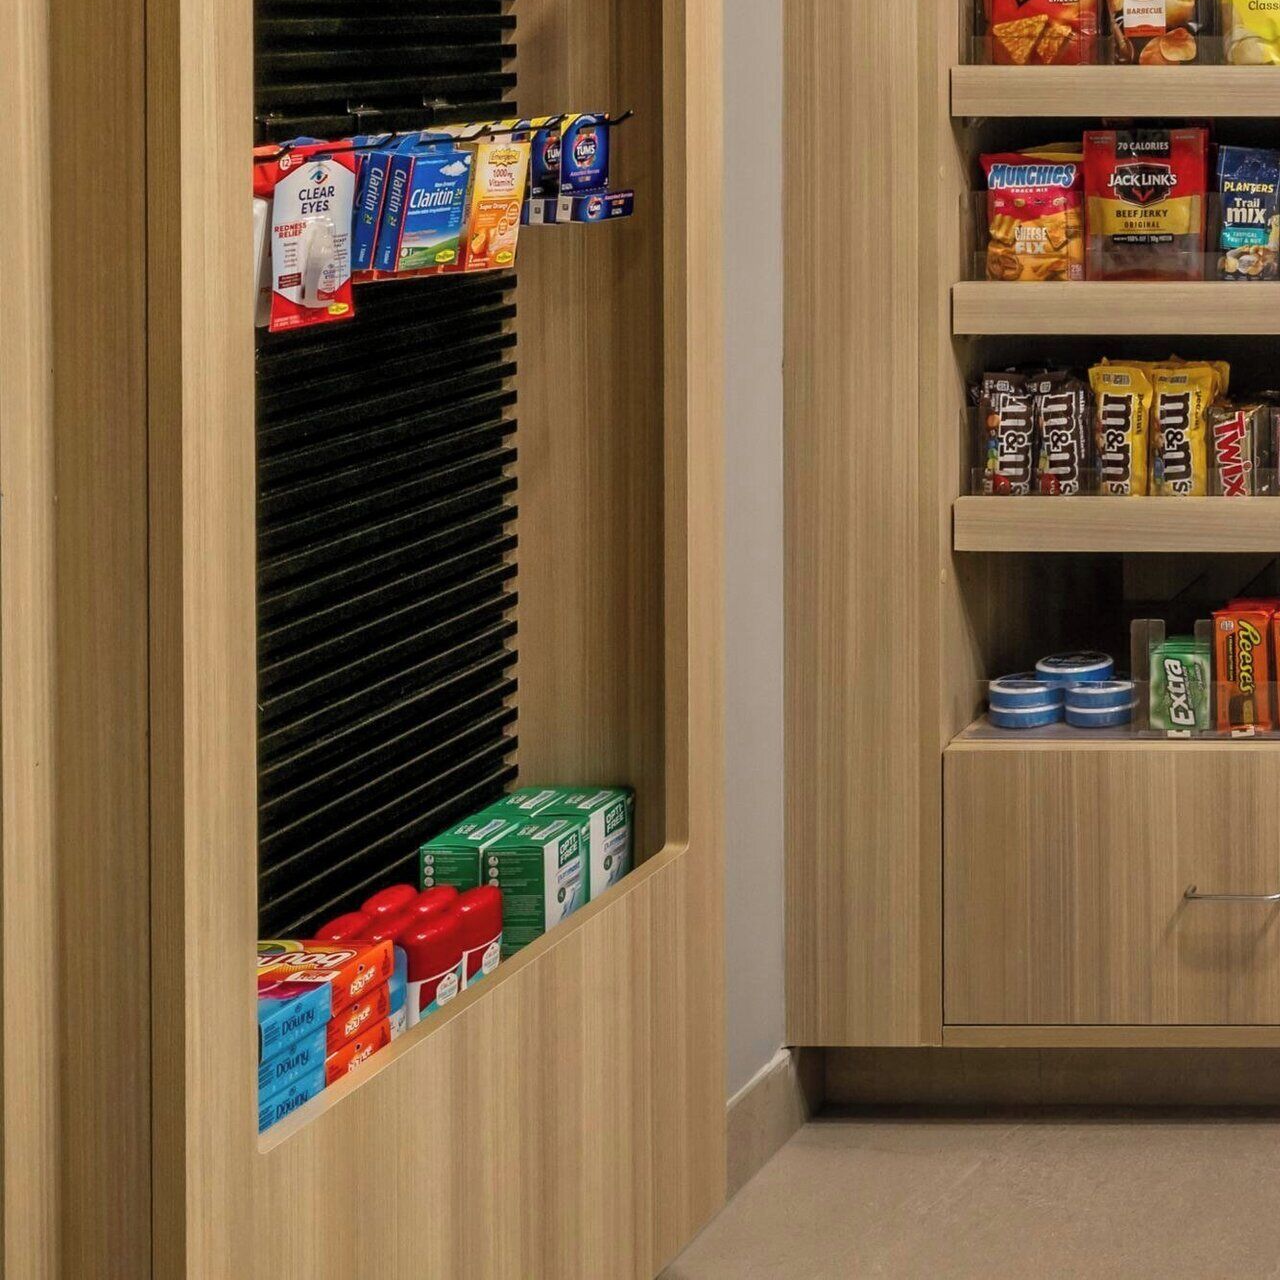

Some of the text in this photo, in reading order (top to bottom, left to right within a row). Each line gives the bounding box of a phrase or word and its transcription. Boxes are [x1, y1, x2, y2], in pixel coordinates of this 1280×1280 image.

[1126, 6, 1163, 15] BARBECUE
[547, 148, 561, 158] TUM
[576, 144, 596, 156] TUMS
[1117, 141, 1170, 151] 70 CALORIES
[988, 164, 1077, 189] MUNCHIES
[1107, 173, 1177, 187] JACK LINK'S
[298, 186, 335, 201] CLEAR
[364, 167, 384, 211] Claritin
[389, 169, 407, 213] Claritin
[1223, 181, 1275, 194] PLANTERS
[409, 189, 454, 209] Claritin
[1234, 197, 1260, 209] Trail
[301, 200, 329, 215] EYES
[1115, 209, 1168, 219] BEEF JERKY
[1226, 206, 1266, 224] mix
[274, 222, 307, 233] REDNESS
[1123, 221, 1160, 229] ORIGINAL
[278, 229, 303, 239] RELIEF
[1015, 227, 1047, 241] CHEESE
[1015, 241, 1045, 255] FIX
[1239, 619, 1262, 693] Reese's
